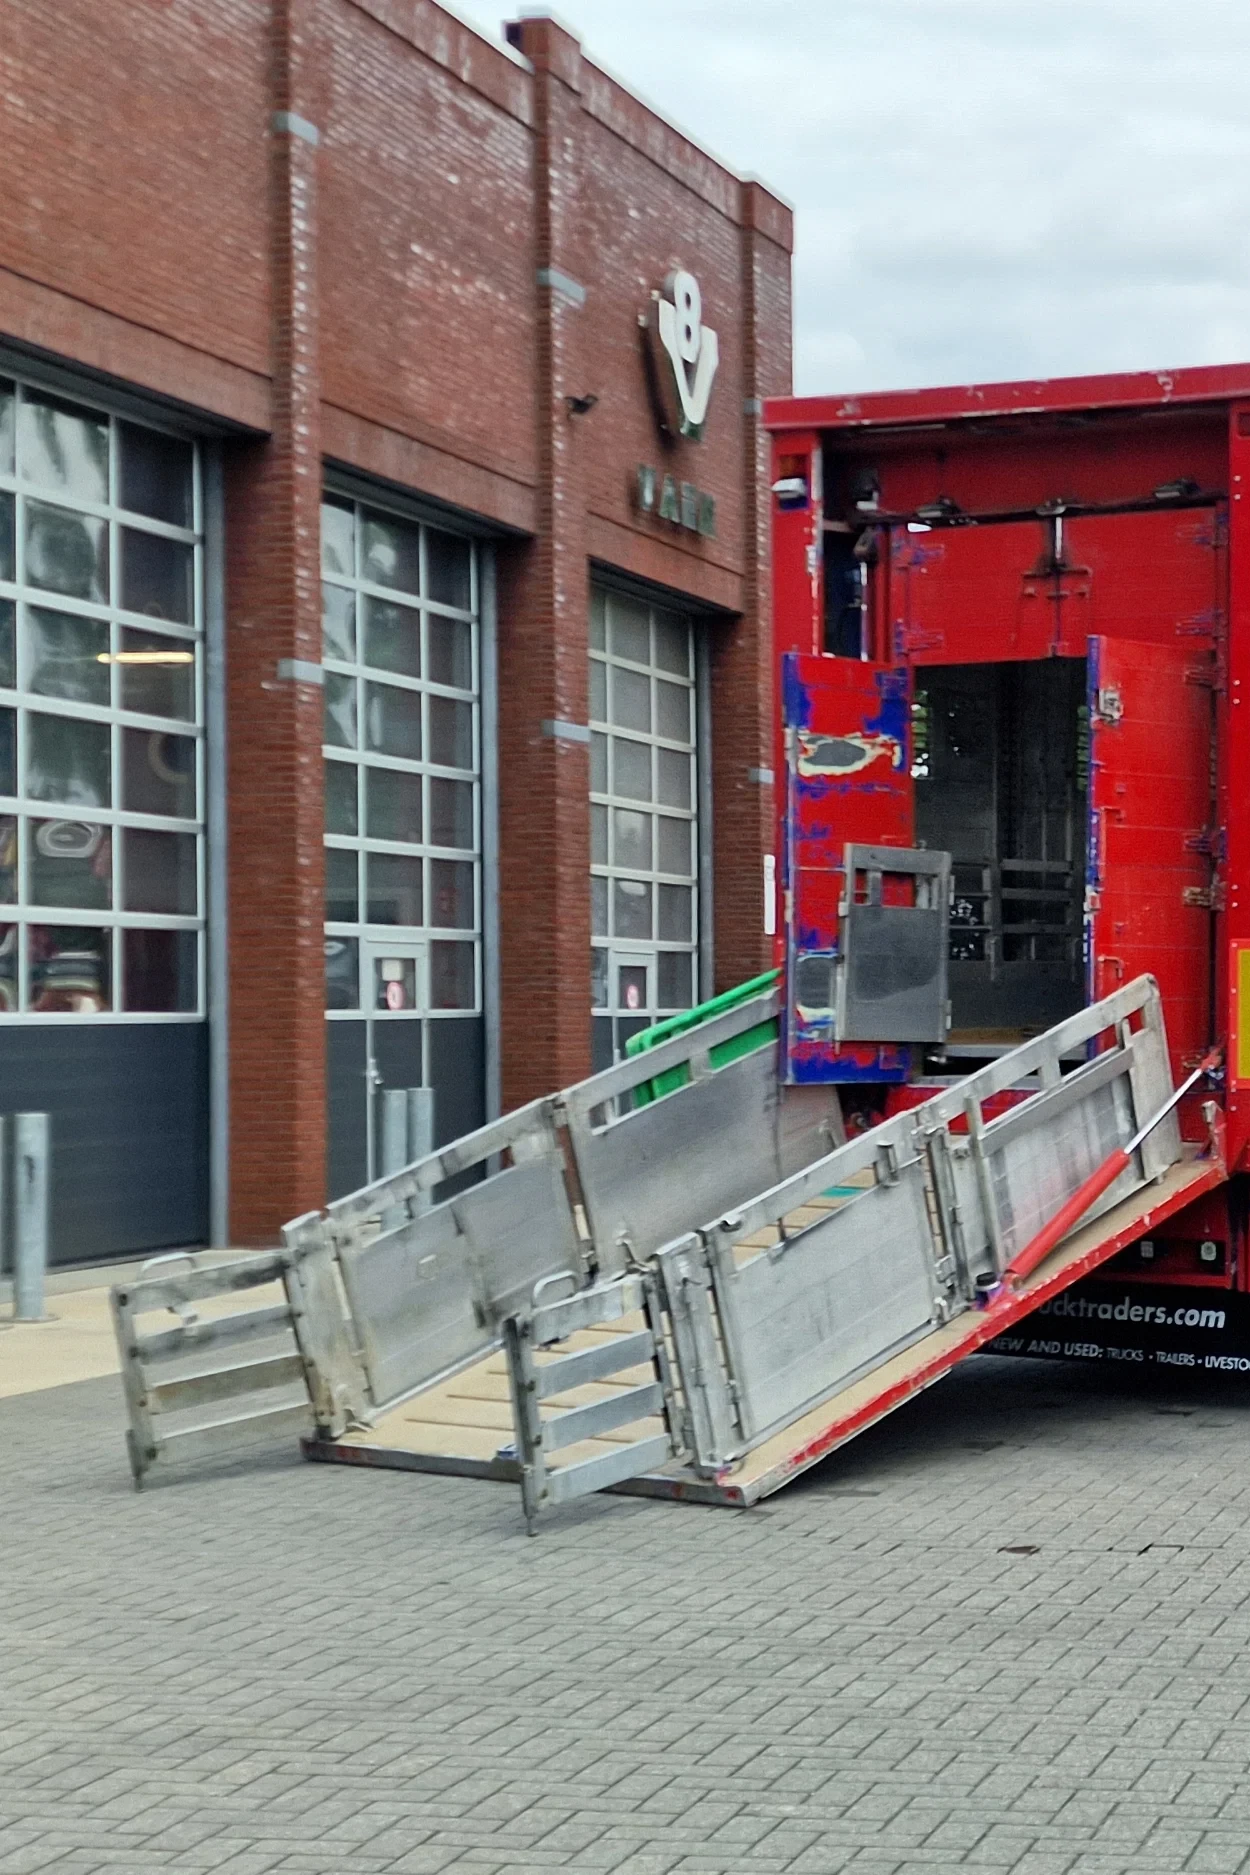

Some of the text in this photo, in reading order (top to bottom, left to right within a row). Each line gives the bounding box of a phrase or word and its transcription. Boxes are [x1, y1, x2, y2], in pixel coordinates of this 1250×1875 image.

[1039, 1293, 1226, 1329] ucktraders.com
[1027, 1339, 1061, 1354] AND
[1064, 1342, 1104, 1358] USED:
[1106, 1347, 1144, 1362] TRUCKS
[1156, 1351, 1196, 1367] TRAILERS
